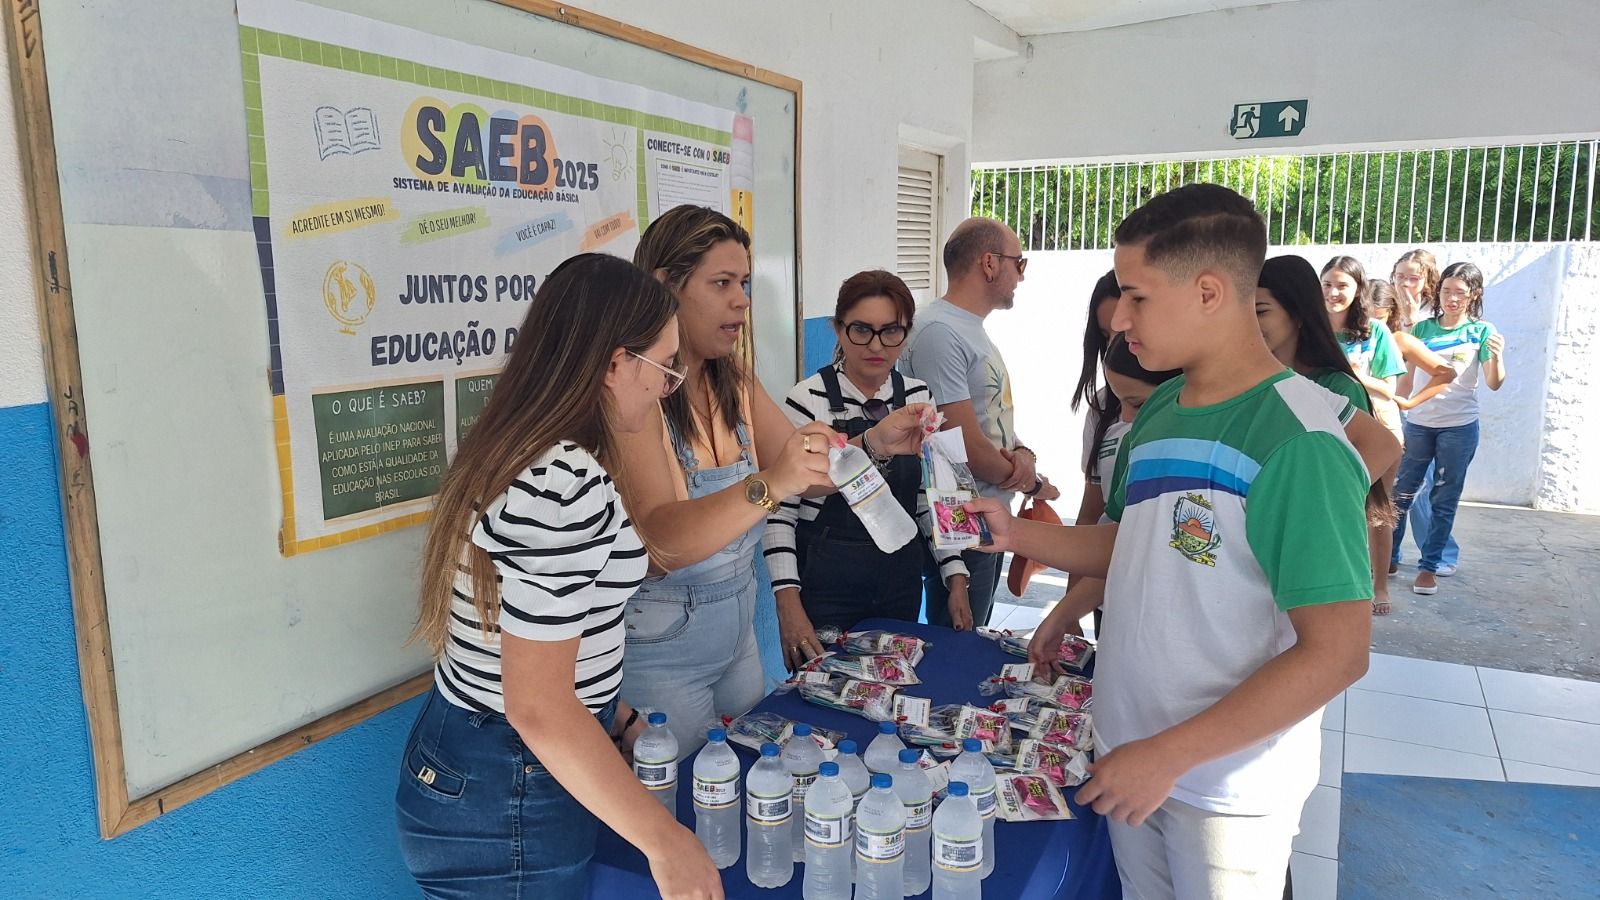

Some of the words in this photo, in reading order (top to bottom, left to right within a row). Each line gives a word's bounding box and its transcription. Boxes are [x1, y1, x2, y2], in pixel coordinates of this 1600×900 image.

[416, 106, 549, 185] SAEB
[647, 138, 692, 157] CONECTE-SE
[706, 150, 710, 161] O
[712, 150, 731, 164] SAEB
[553, 158, 599, 191] 2025
[393, 177, 434, 192] SISTEMA
[438, 181, 449, 192] DE
[453, 182, 496, 198] AVALIAÇÃO
[499, 187, 510, 198] DA
[513, 188, 553, 202] EDUCAÇÃO
[556, 191, 580, 204] BÁSICA
[292, 214, 330, 234] ACREDITE
[331, 211, 344, 226] EM
[344, 209, 354, 223] SI
[354, 203, 385, 221] MESMO!
[418, 219, 429, 235] DÊ
[430, 220, 436, 233] O
[436, 218, 450, 232] SEU
[450, 212, 476, 229] MELHOR!
[516, 225, 534, 242] VOCÊ
[399, 274, 488, 305] JUNTOS
[495, 274, 536, 302] POR
[371, 320, 496, 366] EDUCAÇÃO
[468, 378, 493, 393] QUEM
[332, 399, 341, 415] O
[348, 396, 373, 413] QUE
[379, 391, 385, 408] É
[392, 389, 426, 407] SAEB?
[329, 430, 335, 444] É
[336, 430, 355, 443] UMA
[356, 424, 398, 440] AVALIAÇÃO
[399, 419, 436, 432] NACIONAL
[322, 447, 360, 463] APLICADA
[361, 443, 381, 456] PELO
[382, 440, 401, 453] INEP
[402, 437, 422, 449] PARA
[422, 433, 443, 446] SABER
[332, 463, 357, 478] COMO
[359, 459, 377, 473] ESTÁ
[378, 459, 384, 469] A
[385, 451, 428, 468] QUALIDADE
[429, 449, 439, 459] DA
[332, 476, 375, 496] EDUCAÇÃO
[376, 473, 392, 486] NAS
[393, 468, 428, 482] ESCOLAS
[429, 464, 441, 476] DO
[375, 488, 401, 503] BRASIL
